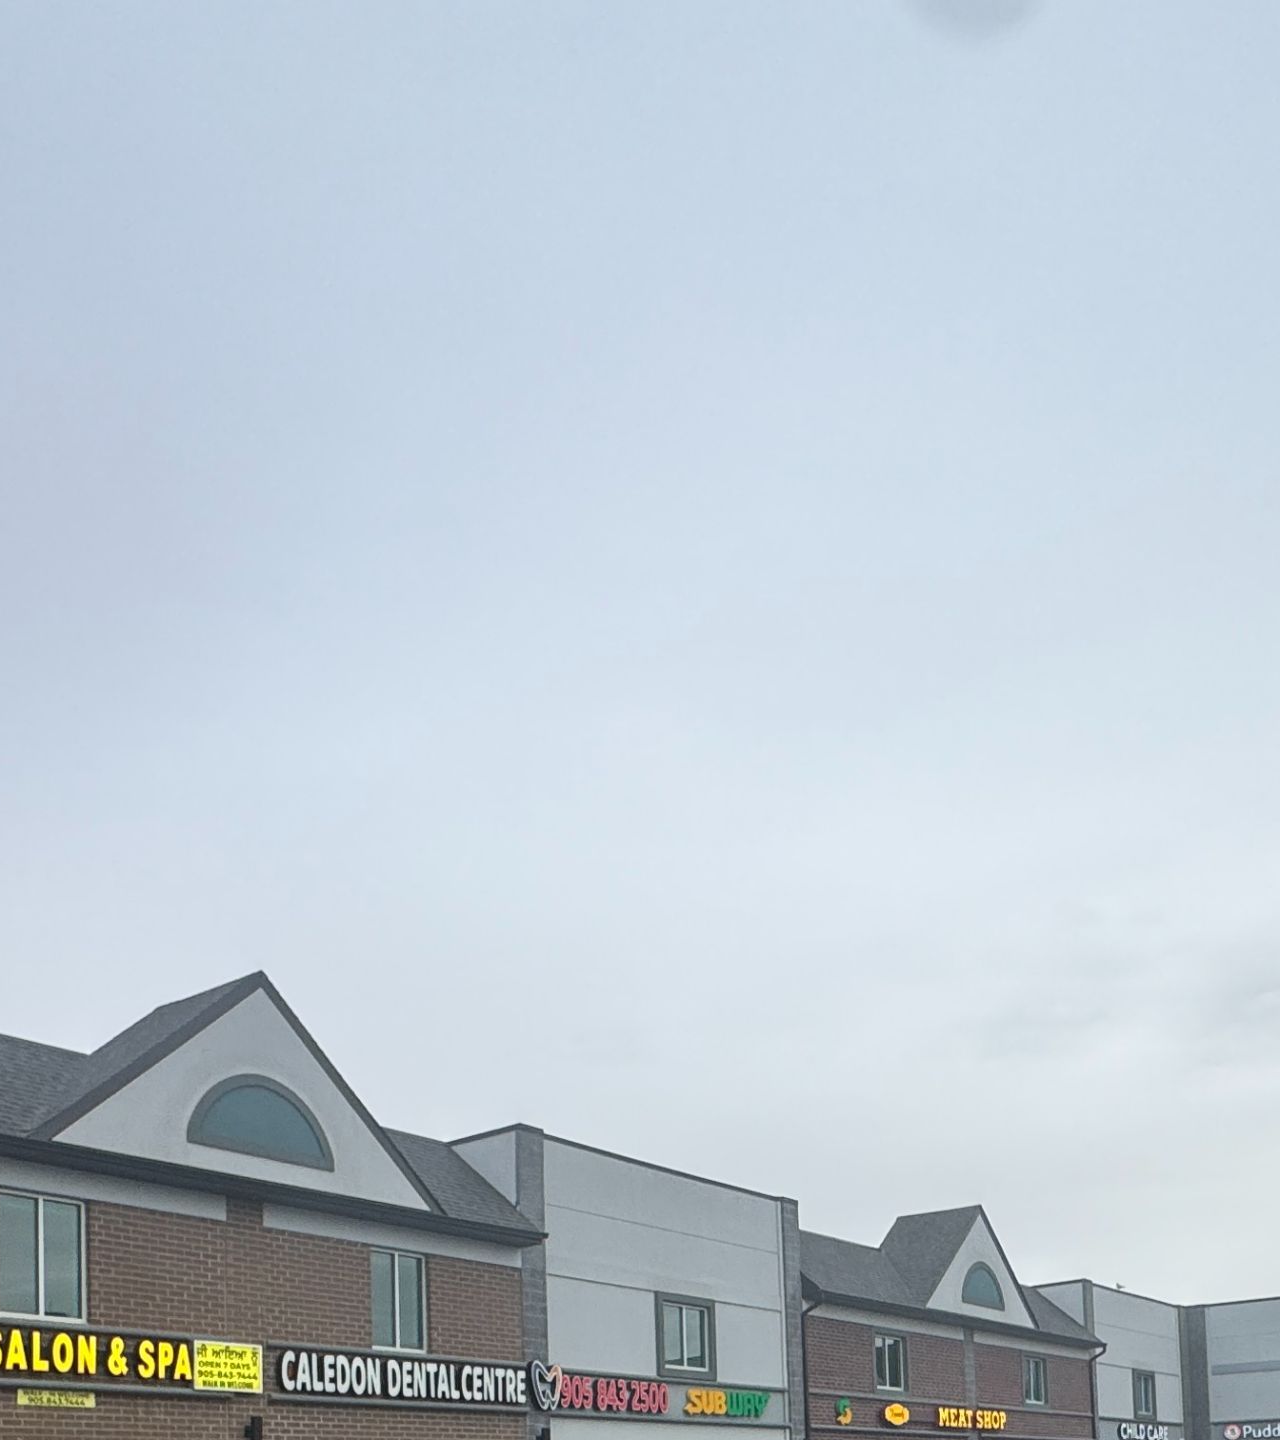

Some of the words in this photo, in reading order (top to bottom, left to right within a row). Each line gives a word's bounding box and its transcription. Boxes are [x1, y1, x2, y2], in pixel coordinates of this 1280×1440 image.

[107, 1336, 128, 1376] &
[138, 1339, 193, 1380] SPA
[199, 1360, 221, 1368] OPEN
[198, 1370, 258, 1380] 905-843-7444
[281, 1350, 381, 1396] CALEDON
[386, 1359, 461, 1399] DENTAL
[461, 1365, 526, 1403] CENTRE
[560, 1374, 593, 1409] 905
[596, 1377, 627, 1412] 843
[631, 1380, 670, 1414] 2500
[684, 1387, 770, 1418] SUBWAY
[939, 1407, 972, 1428] MEAT
[976, 1409, 1007, 1430] SHOP
[1120, 1422, 1145, 1440] CHILD
[1147, 1424, 1168, 1440] CARE
